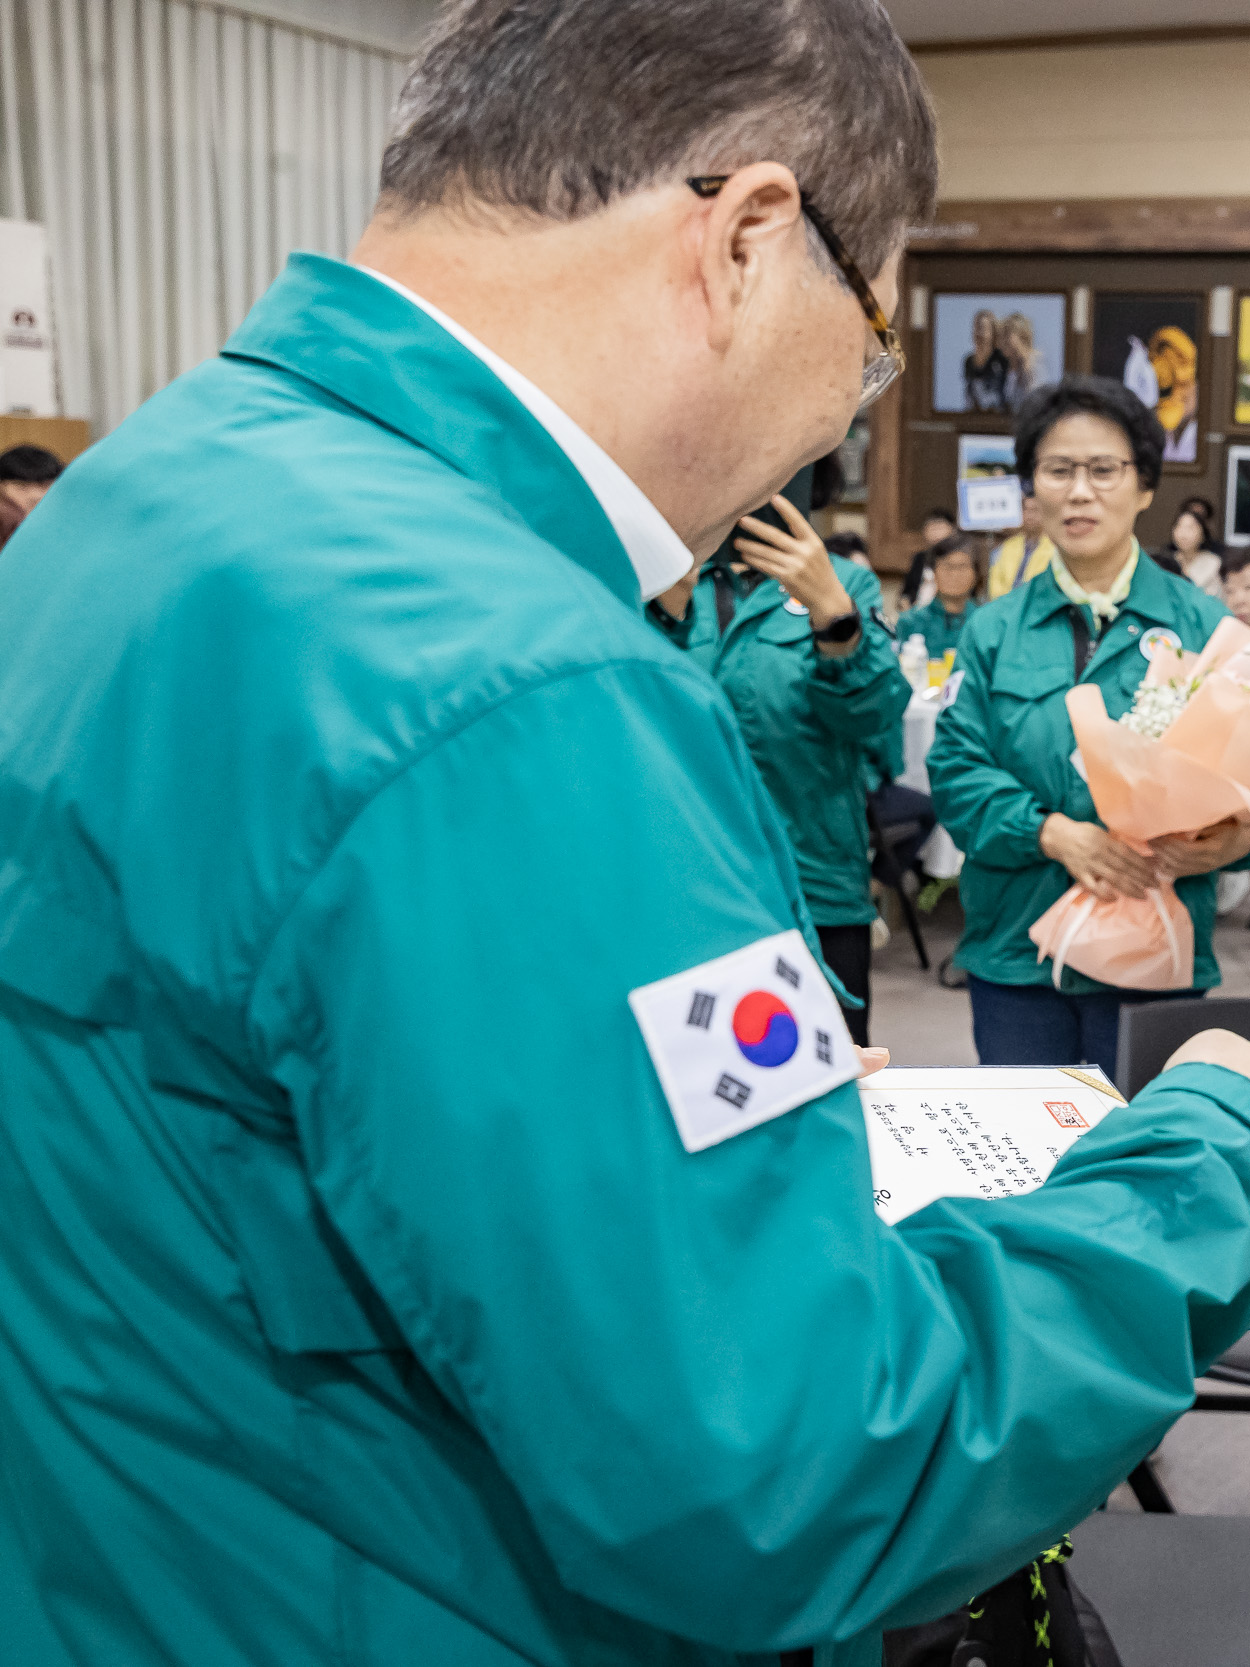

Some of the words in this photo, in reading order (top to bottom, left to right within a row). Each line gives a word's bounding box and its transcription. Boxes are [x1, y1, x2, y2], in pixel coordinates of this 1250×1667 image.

[955, 1101, 983, 1129] 기여한
[938, 1127, 978, 1177] 사명감으로
[967, 1142, 996, 1172] 공헌해
[980, 1134, 1008, 1163] 발전에
[1005, 1168, 1027, 1188] 업무
